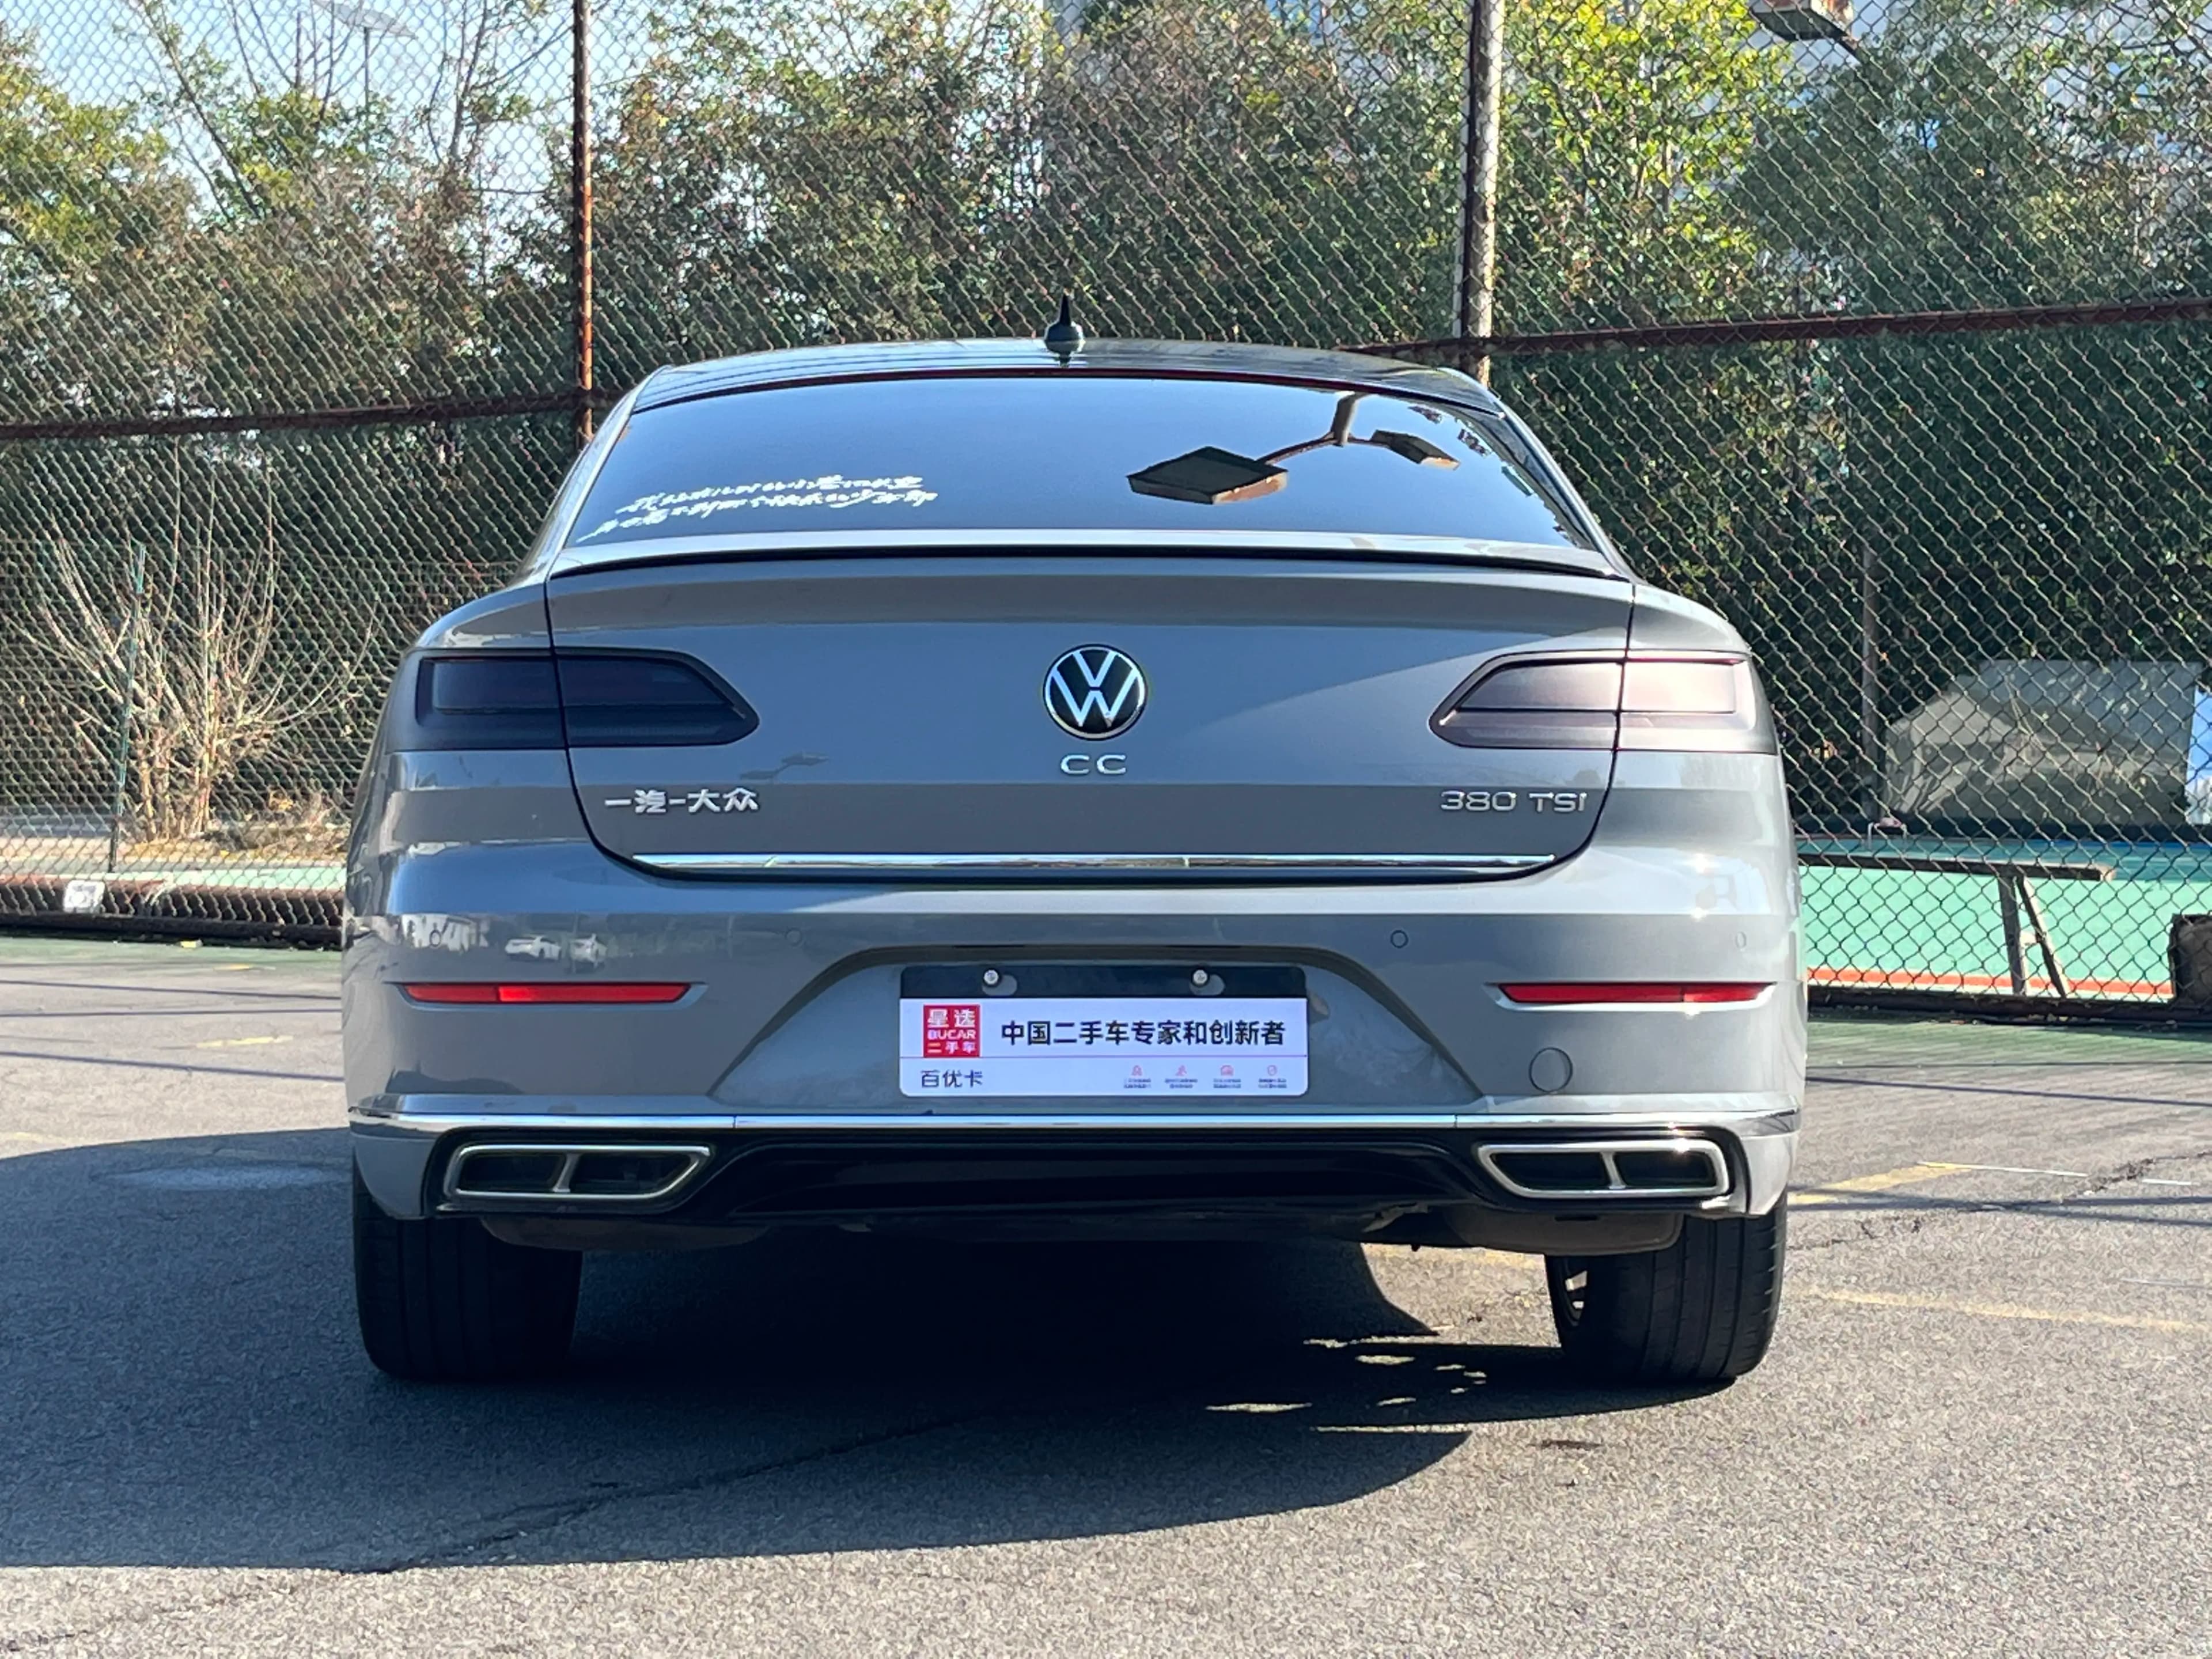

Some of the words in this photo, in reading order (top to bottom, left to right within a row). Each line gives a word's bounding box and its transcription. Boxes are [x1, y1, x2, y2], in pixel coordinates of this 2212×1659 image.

[1060, 754, 1127, 774] CC
[604, 787, 760, 813] 一汽-大众
[1440, 790, 1517, 812] 380
[1528, 791, 1588, 813] TSI
[927, 1029, 976, 1040] BUCAR
[1001, 1019, 1286, 1046] 中国二手车专家和创新者
[927, 1040, 976, 1054] 二手车
[921, 1069, 983, 1088] 百优卡
